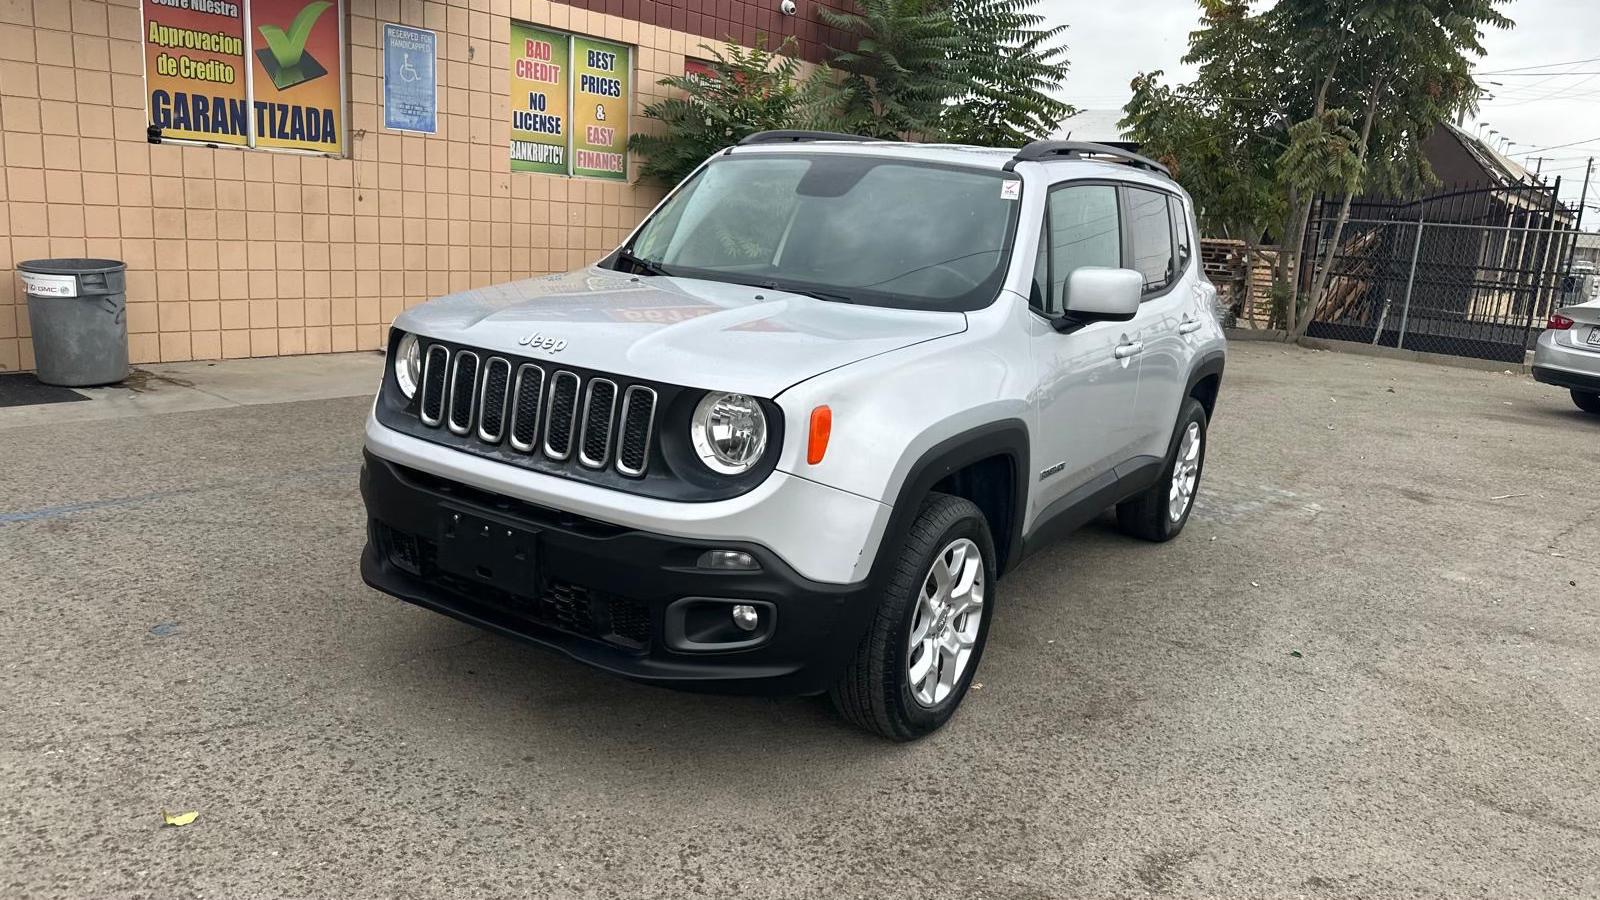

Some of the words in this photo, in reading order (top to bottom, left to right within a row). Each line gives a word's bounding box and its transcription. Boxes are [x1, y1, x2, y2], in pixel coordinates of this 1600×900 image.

[190, 0, 239, 18] Nuestra
[149, 21, 243, 55] Approvacion
[388, 28, 419, 41] RESERVED
[420, 34, 433, 42] FOR
[391, 38, 431, 52] HANDICAPPED
[525, 39, 552, 61] BAD
[587, 50, 615, 71] BEST
[157, 54, 177, 76] de
[179, 56, 235, 84] Credito
[515, 59, 560, 84] CREDIT
[580, 74, 621, 98] PRICES
[529, 92, 546, 112] NO
[595, 104, 606, 121] &
[152, 89, 337, 144] GARANTIZADA
[513, 110, 562, 135] LICENSE
[586, 126, 614, 147] EASY
[511, 140, 564, 164] BANKRUPTCY
[576, 151, 623, 172] FINANCE
[518, 331, 568, 355] Jeep
